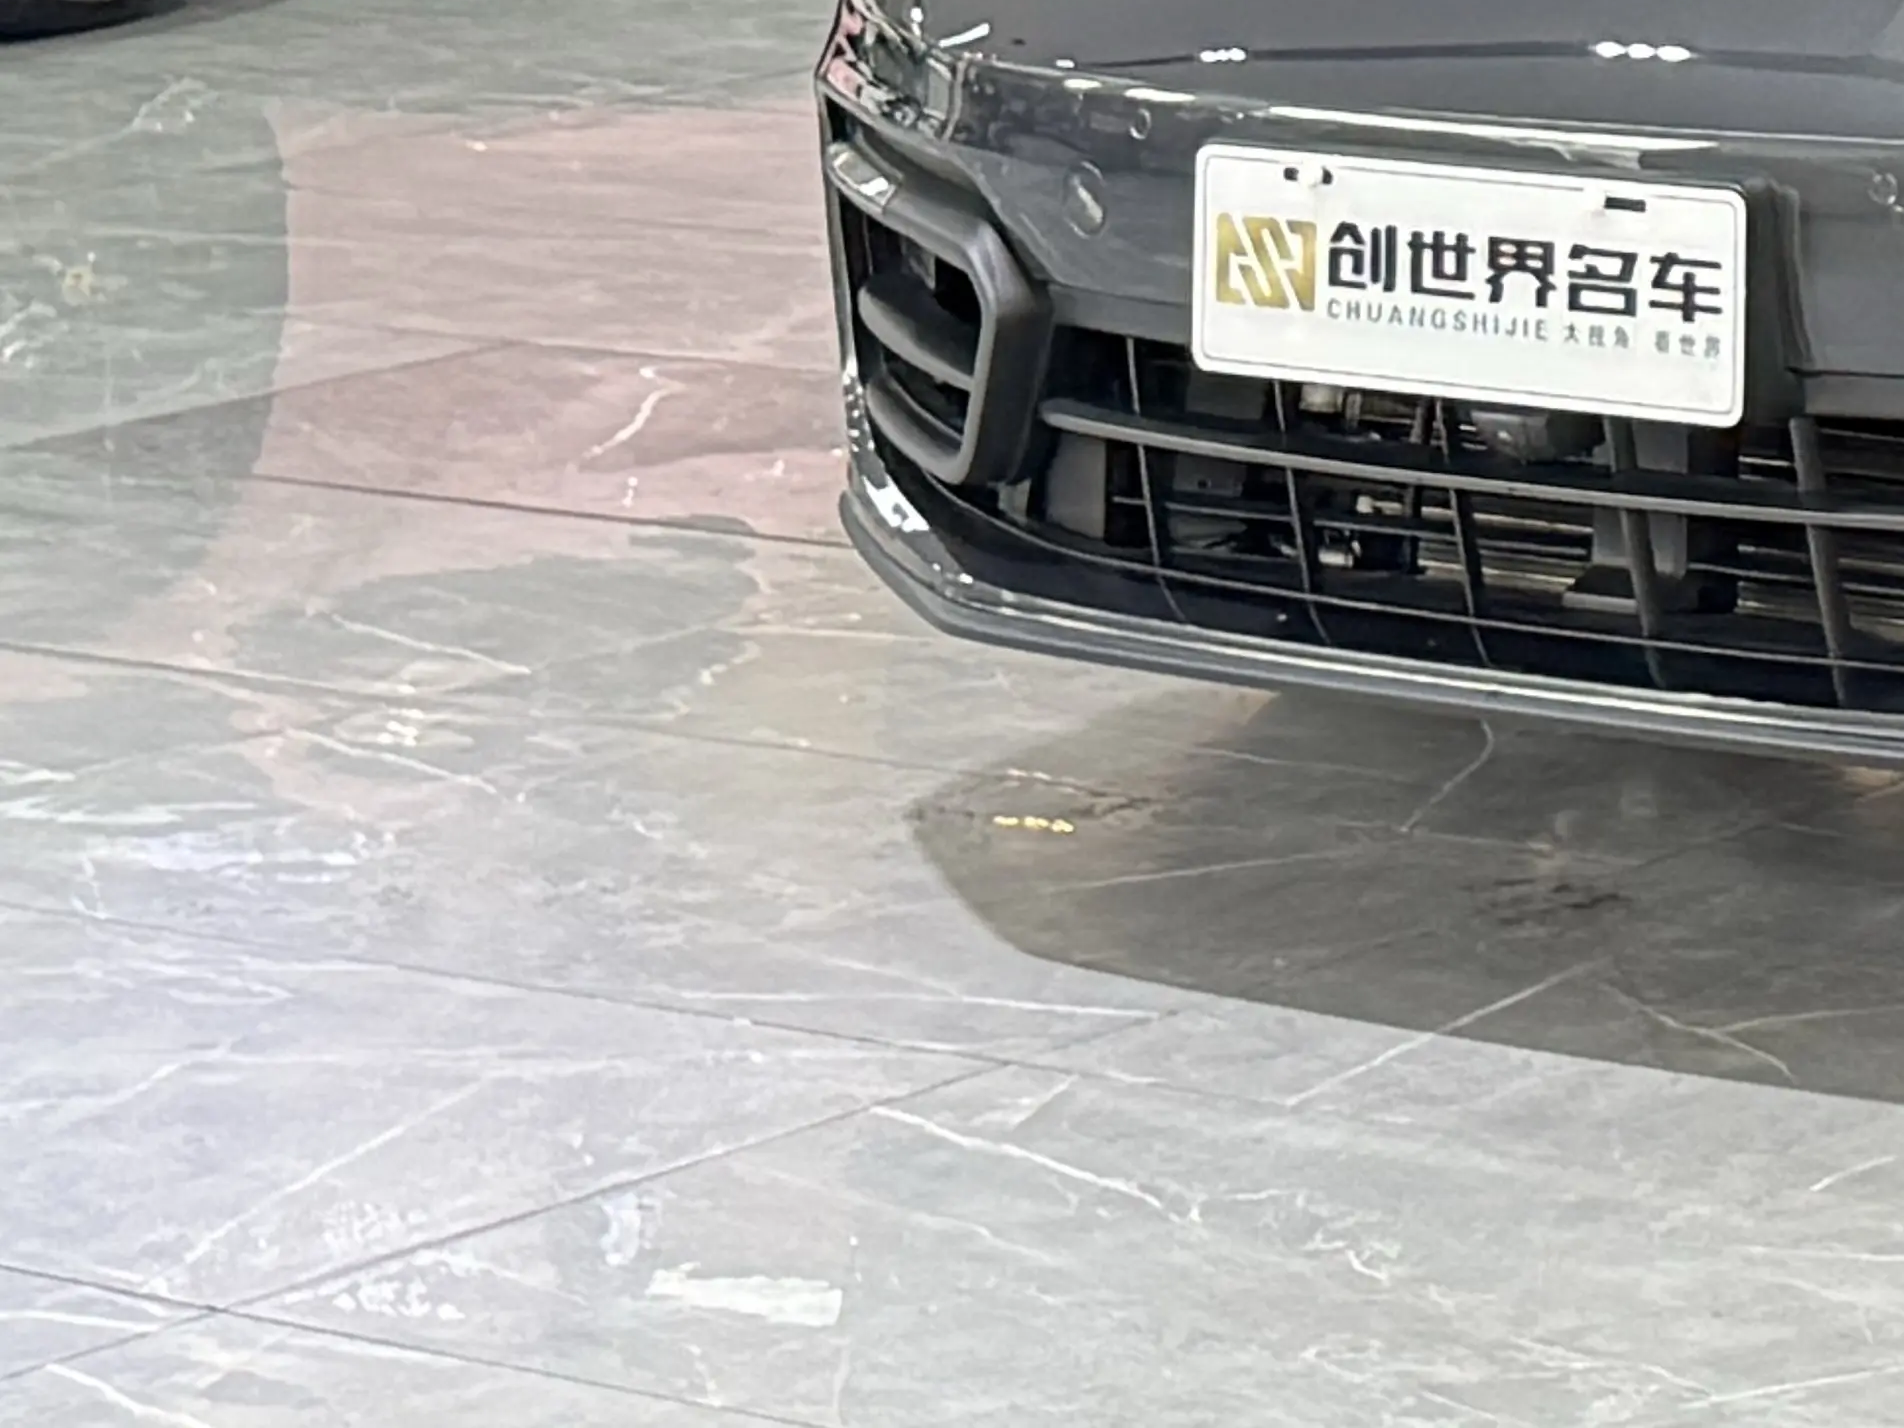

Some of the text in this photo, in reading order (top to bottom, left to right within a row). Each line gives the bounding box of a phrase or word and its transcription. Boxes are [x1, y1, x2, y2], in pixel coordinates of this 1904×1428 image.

[1328, 221, 1724, 323] 创世界名车
[1326, 297, 1549, 343] CHUANGSHIJIE
